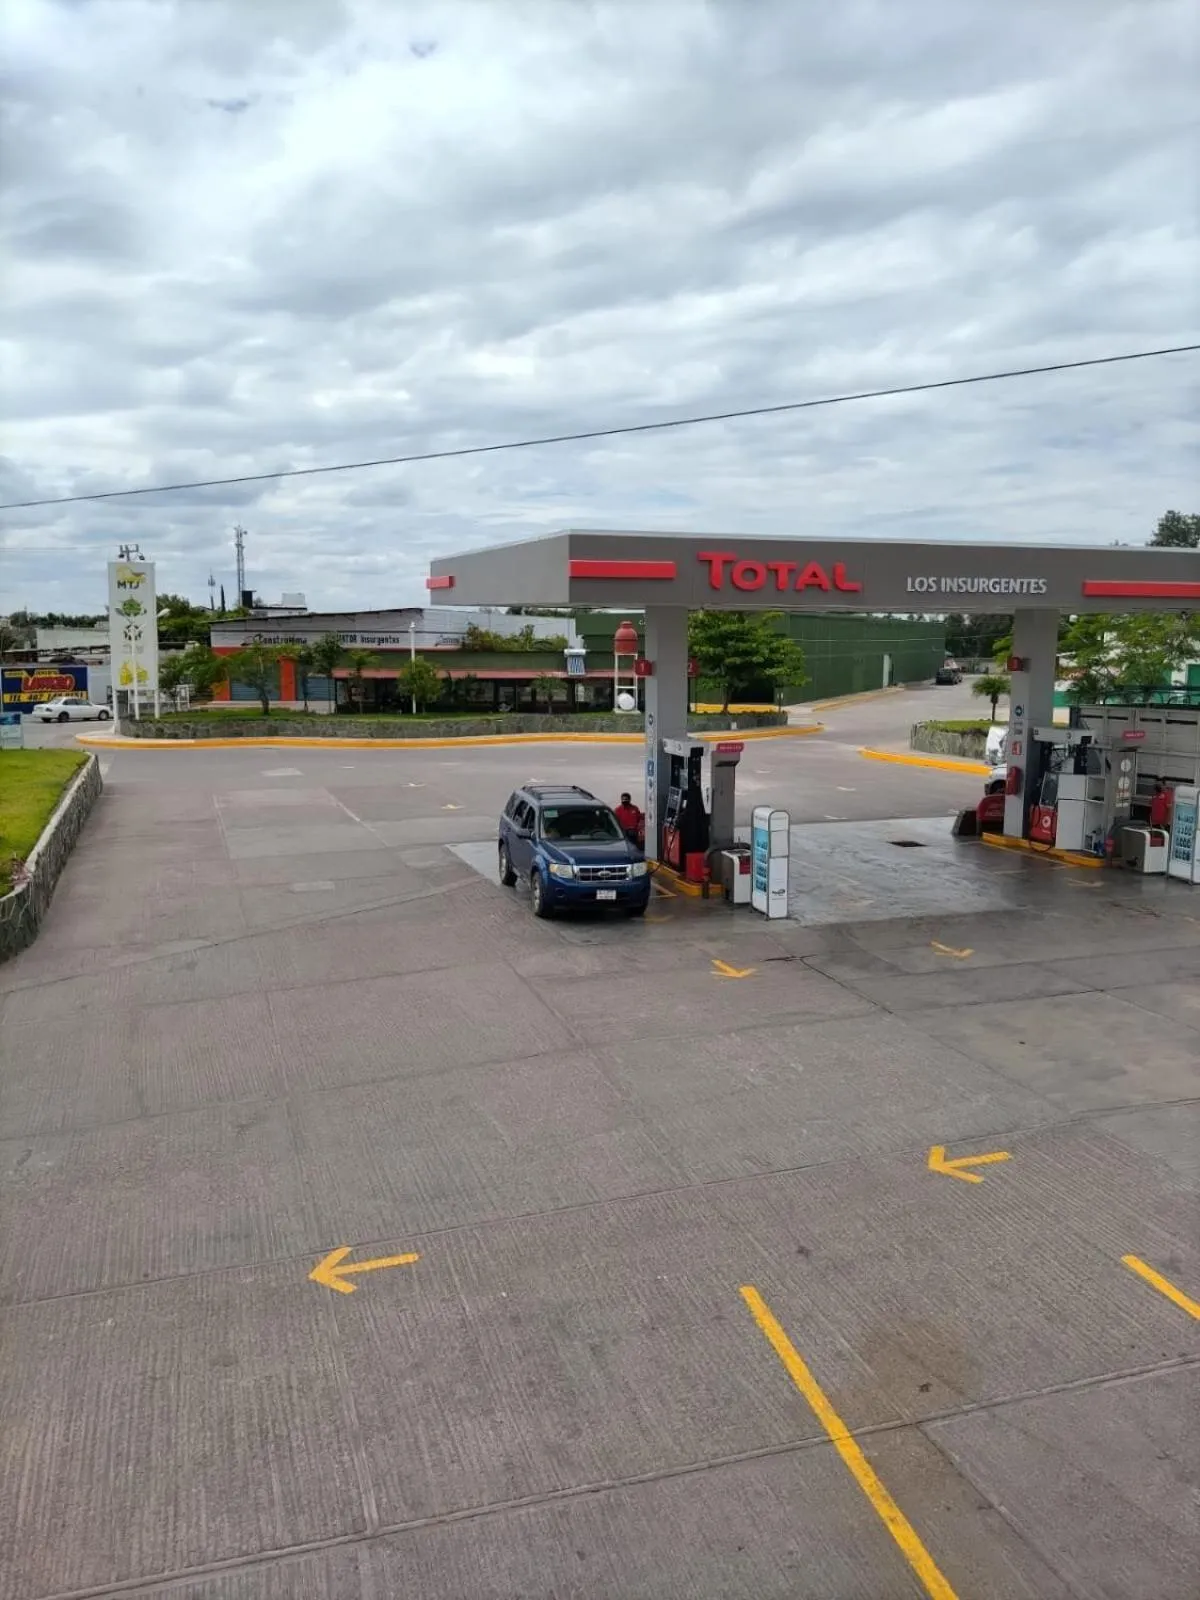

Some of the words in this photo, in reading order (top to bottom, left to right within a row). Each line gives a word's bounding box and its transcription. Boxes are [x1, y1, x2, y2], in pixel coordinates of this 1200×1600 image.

[697, 551, 862, 593] TOTAL
[906, 576, 938, 593] LOS
[940, 577, 1048, 595] INSURGENTES
